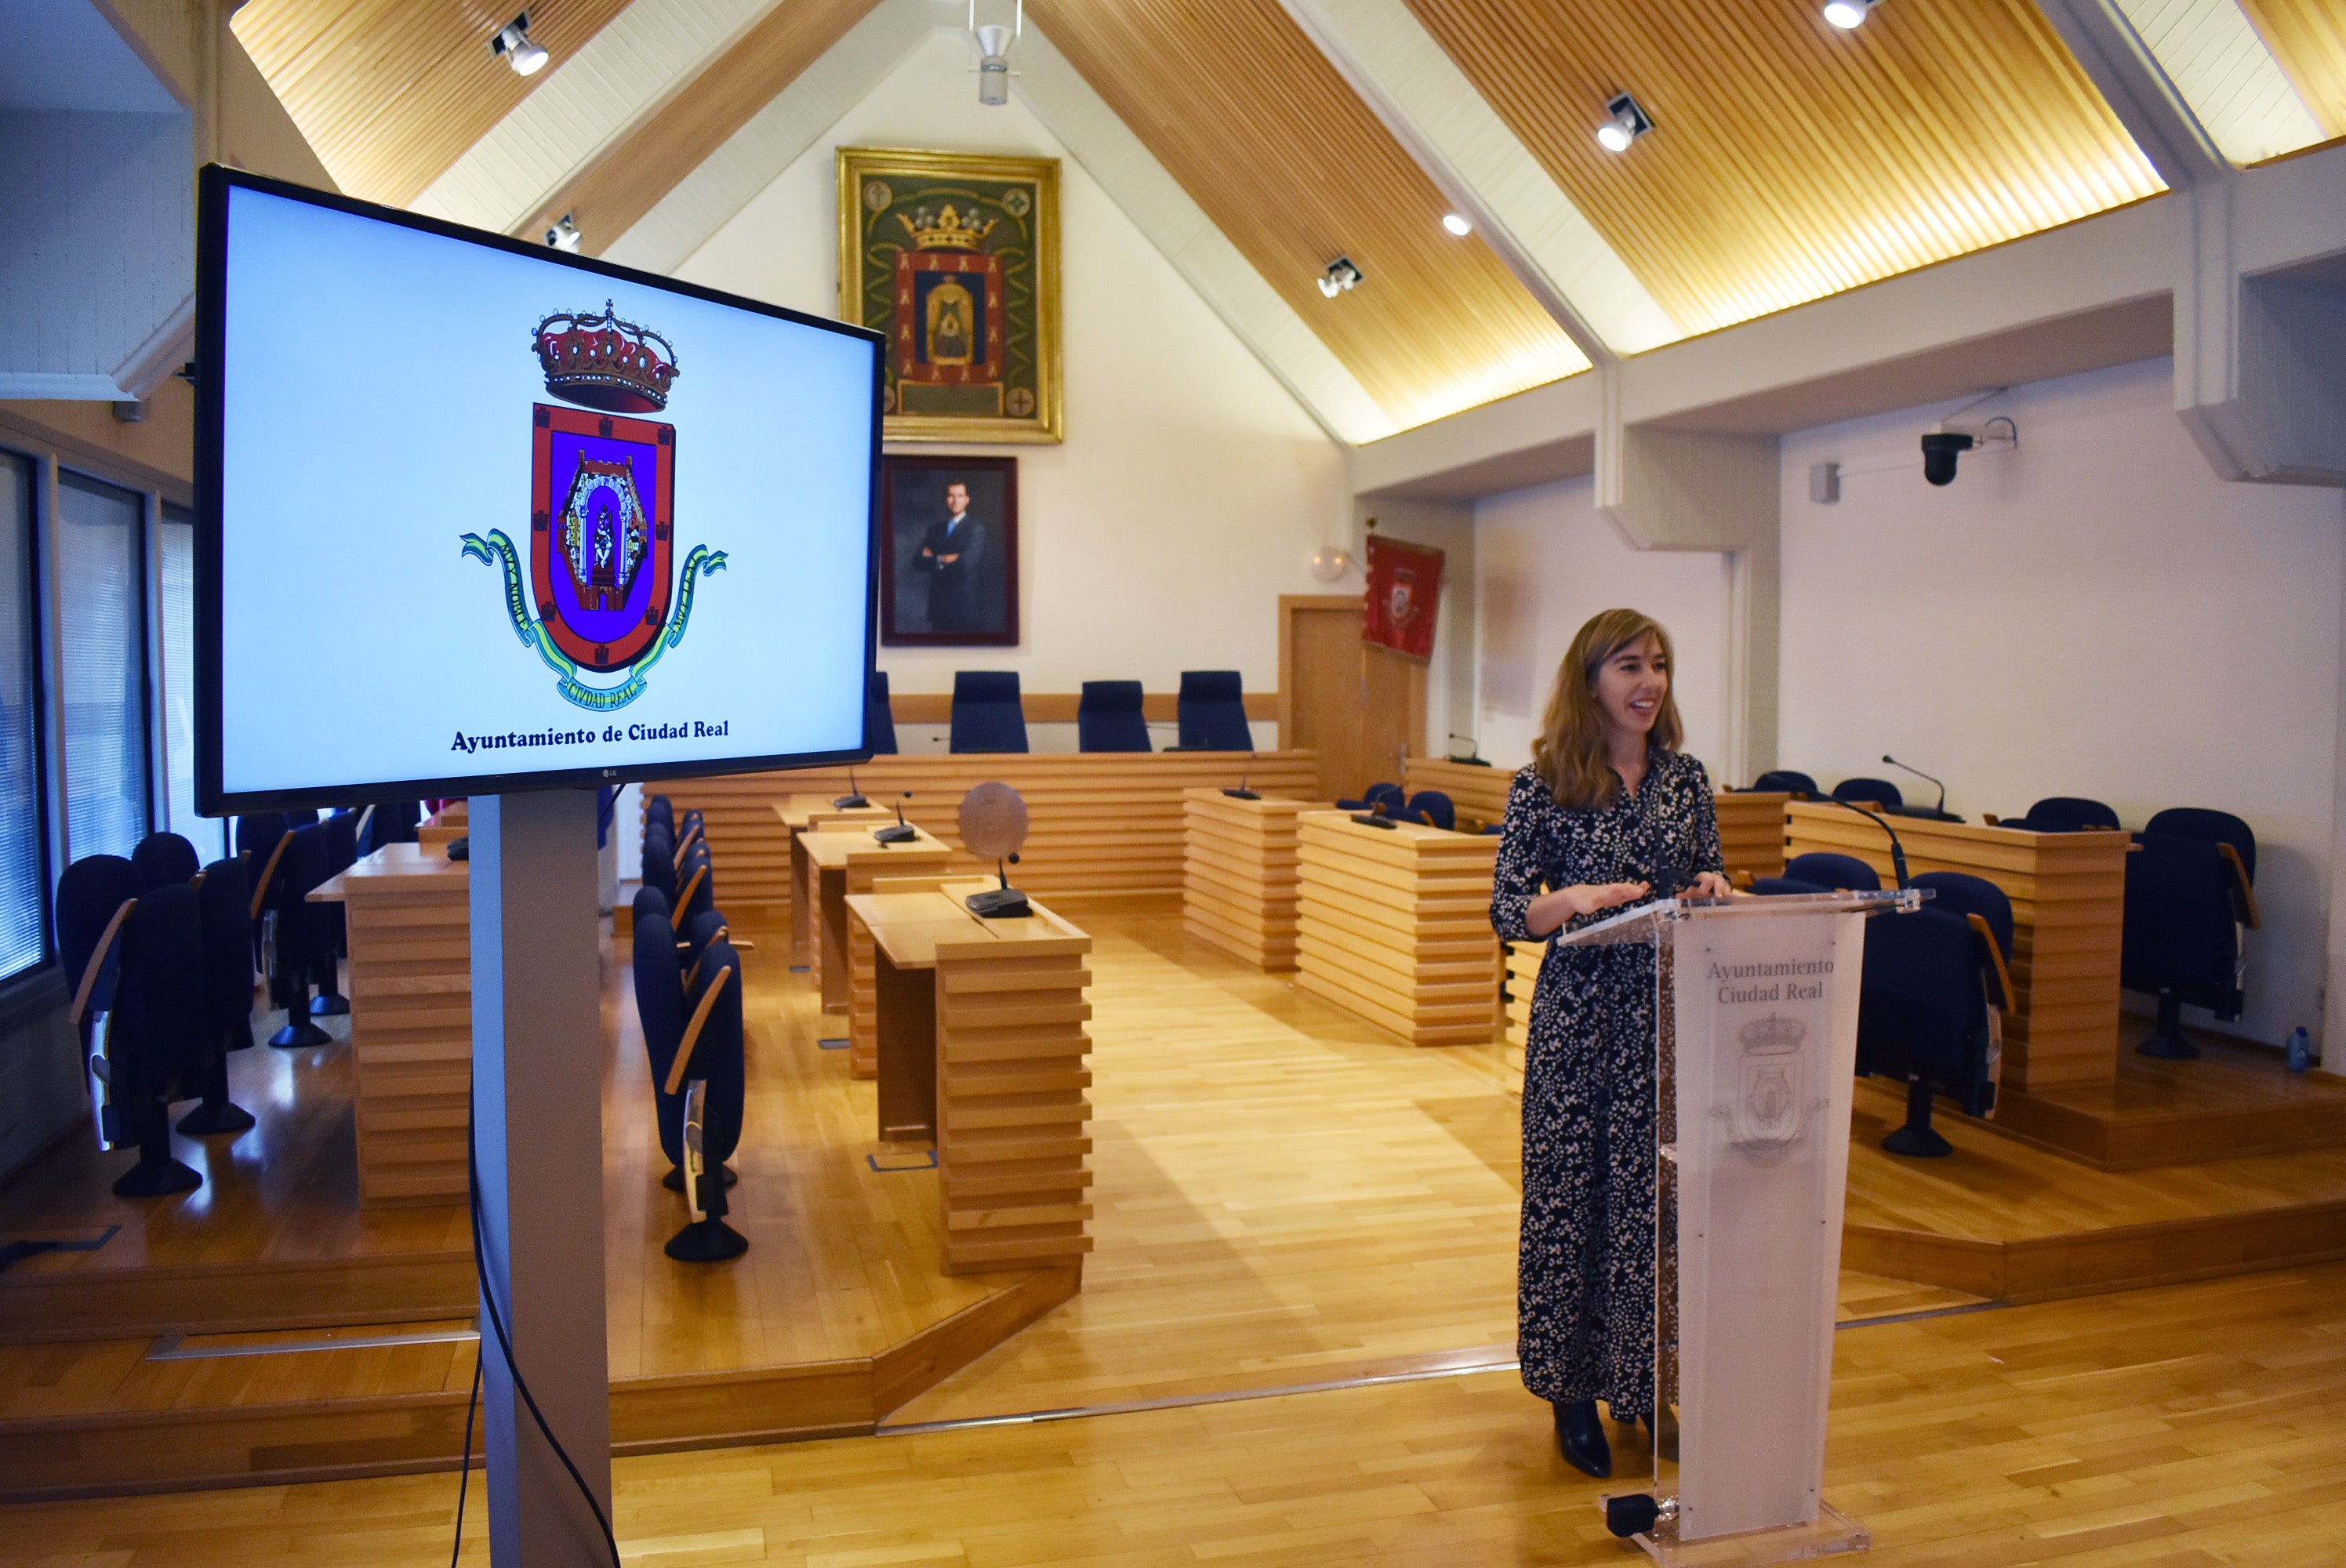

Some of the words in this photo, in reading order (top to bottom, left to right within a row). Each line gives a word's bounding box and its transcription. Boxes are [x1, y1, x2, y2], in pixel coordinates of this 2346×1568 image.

[507, 582, 530, 631] NOBLE
[610, 685, 637, 708] REAL
[451, 728, 596, 754] Ayuntamiento
[602, 725, 623, 742] de
[628, 722, 688, 741] Ciudad
[694, 720, 728, 738] Real
[1707, 959, 1835, 982] Ayuntamiento
[1718, 983, 1780, 1004] Ciudad
[1786, 982, 1824, 1000] Real
